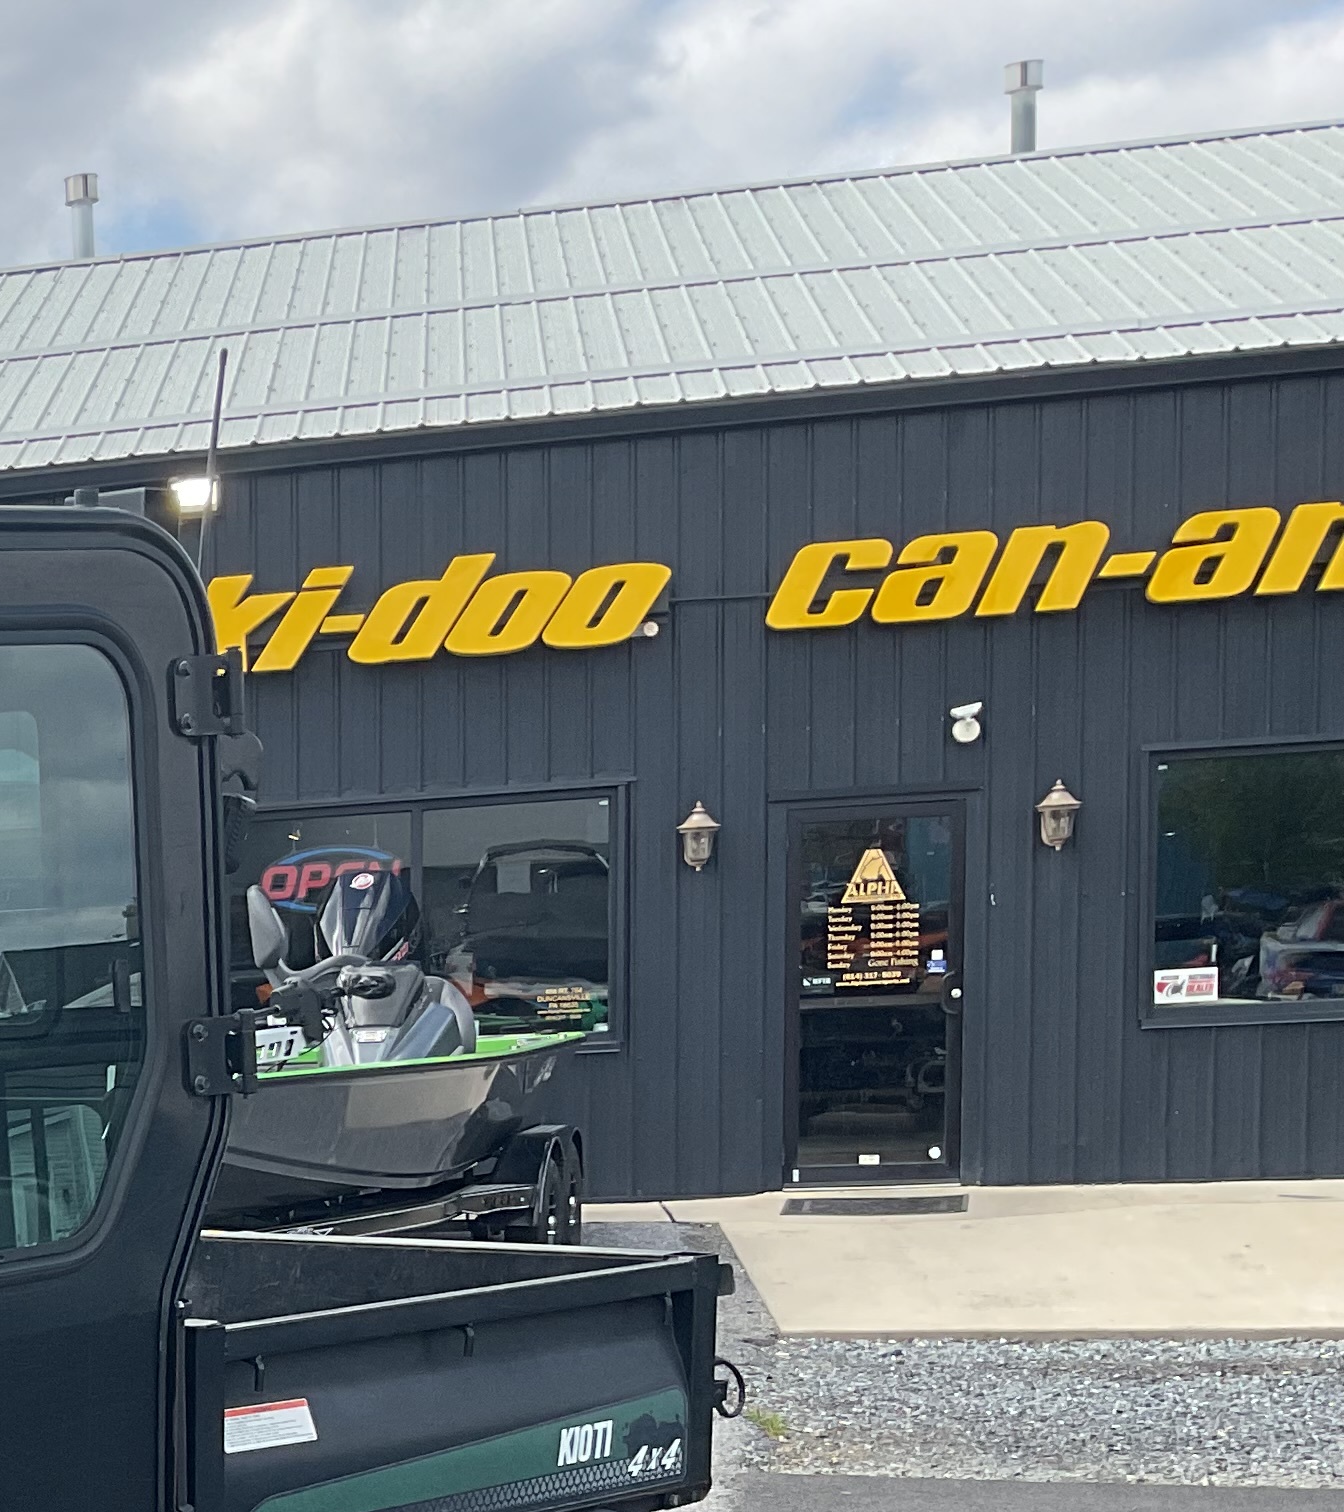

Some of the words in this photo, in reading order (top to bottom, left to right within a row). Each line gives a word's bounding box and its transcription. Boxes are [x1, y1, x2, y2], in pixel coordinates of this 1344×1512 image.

[207, 552, 673, 672] ki-doo
[847, 881, 903, 896] ALPHA
[557, 1420, 613, 1467] KIOTI
[628, 1438, 682, 1477] 4x4
